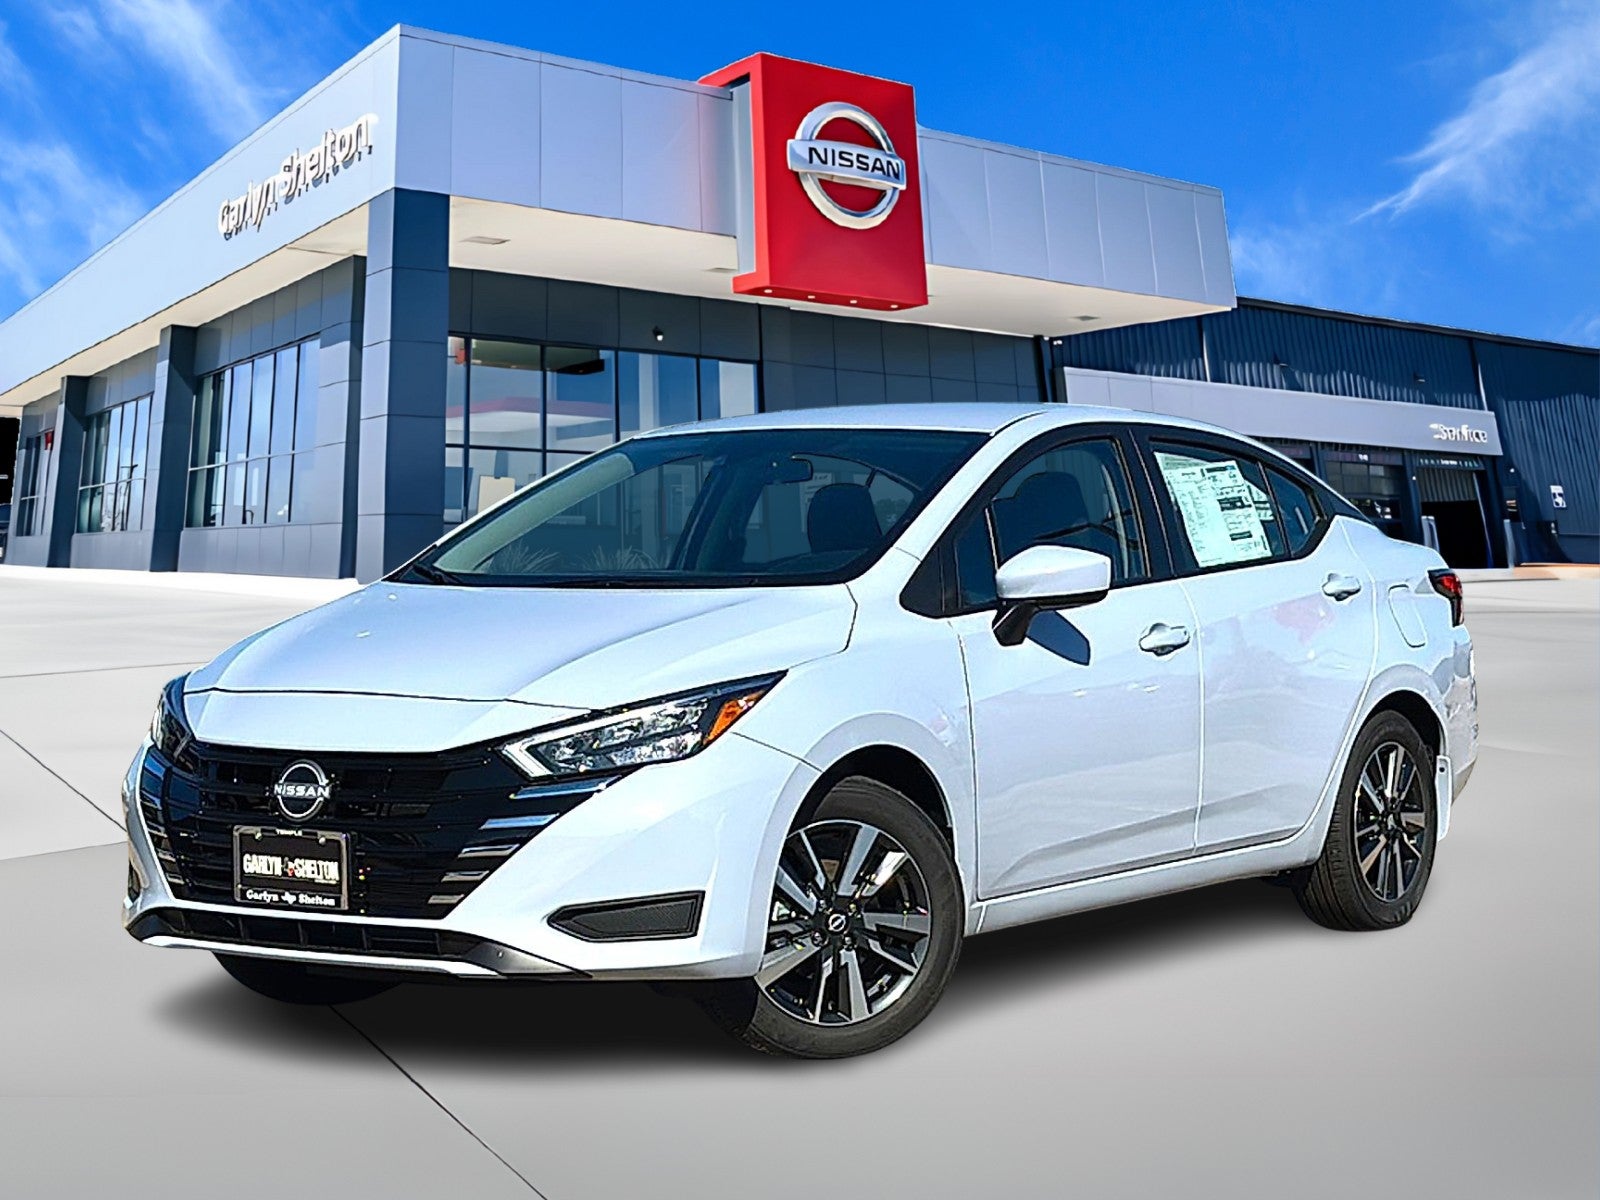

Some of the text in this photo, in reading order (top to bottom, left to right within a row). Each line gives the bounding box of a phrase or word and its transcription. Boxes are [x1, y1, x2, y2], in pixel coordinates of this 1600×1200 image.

[279, 116, 372, 200] Shelton
[808, 146, 900, 180] NISSAN
[274, 784, 330, 798] NISSAN
[243, 853, 339, 880] GARLYN SHELTON
[246, 889, 336, 906] Garlyn Shelton
